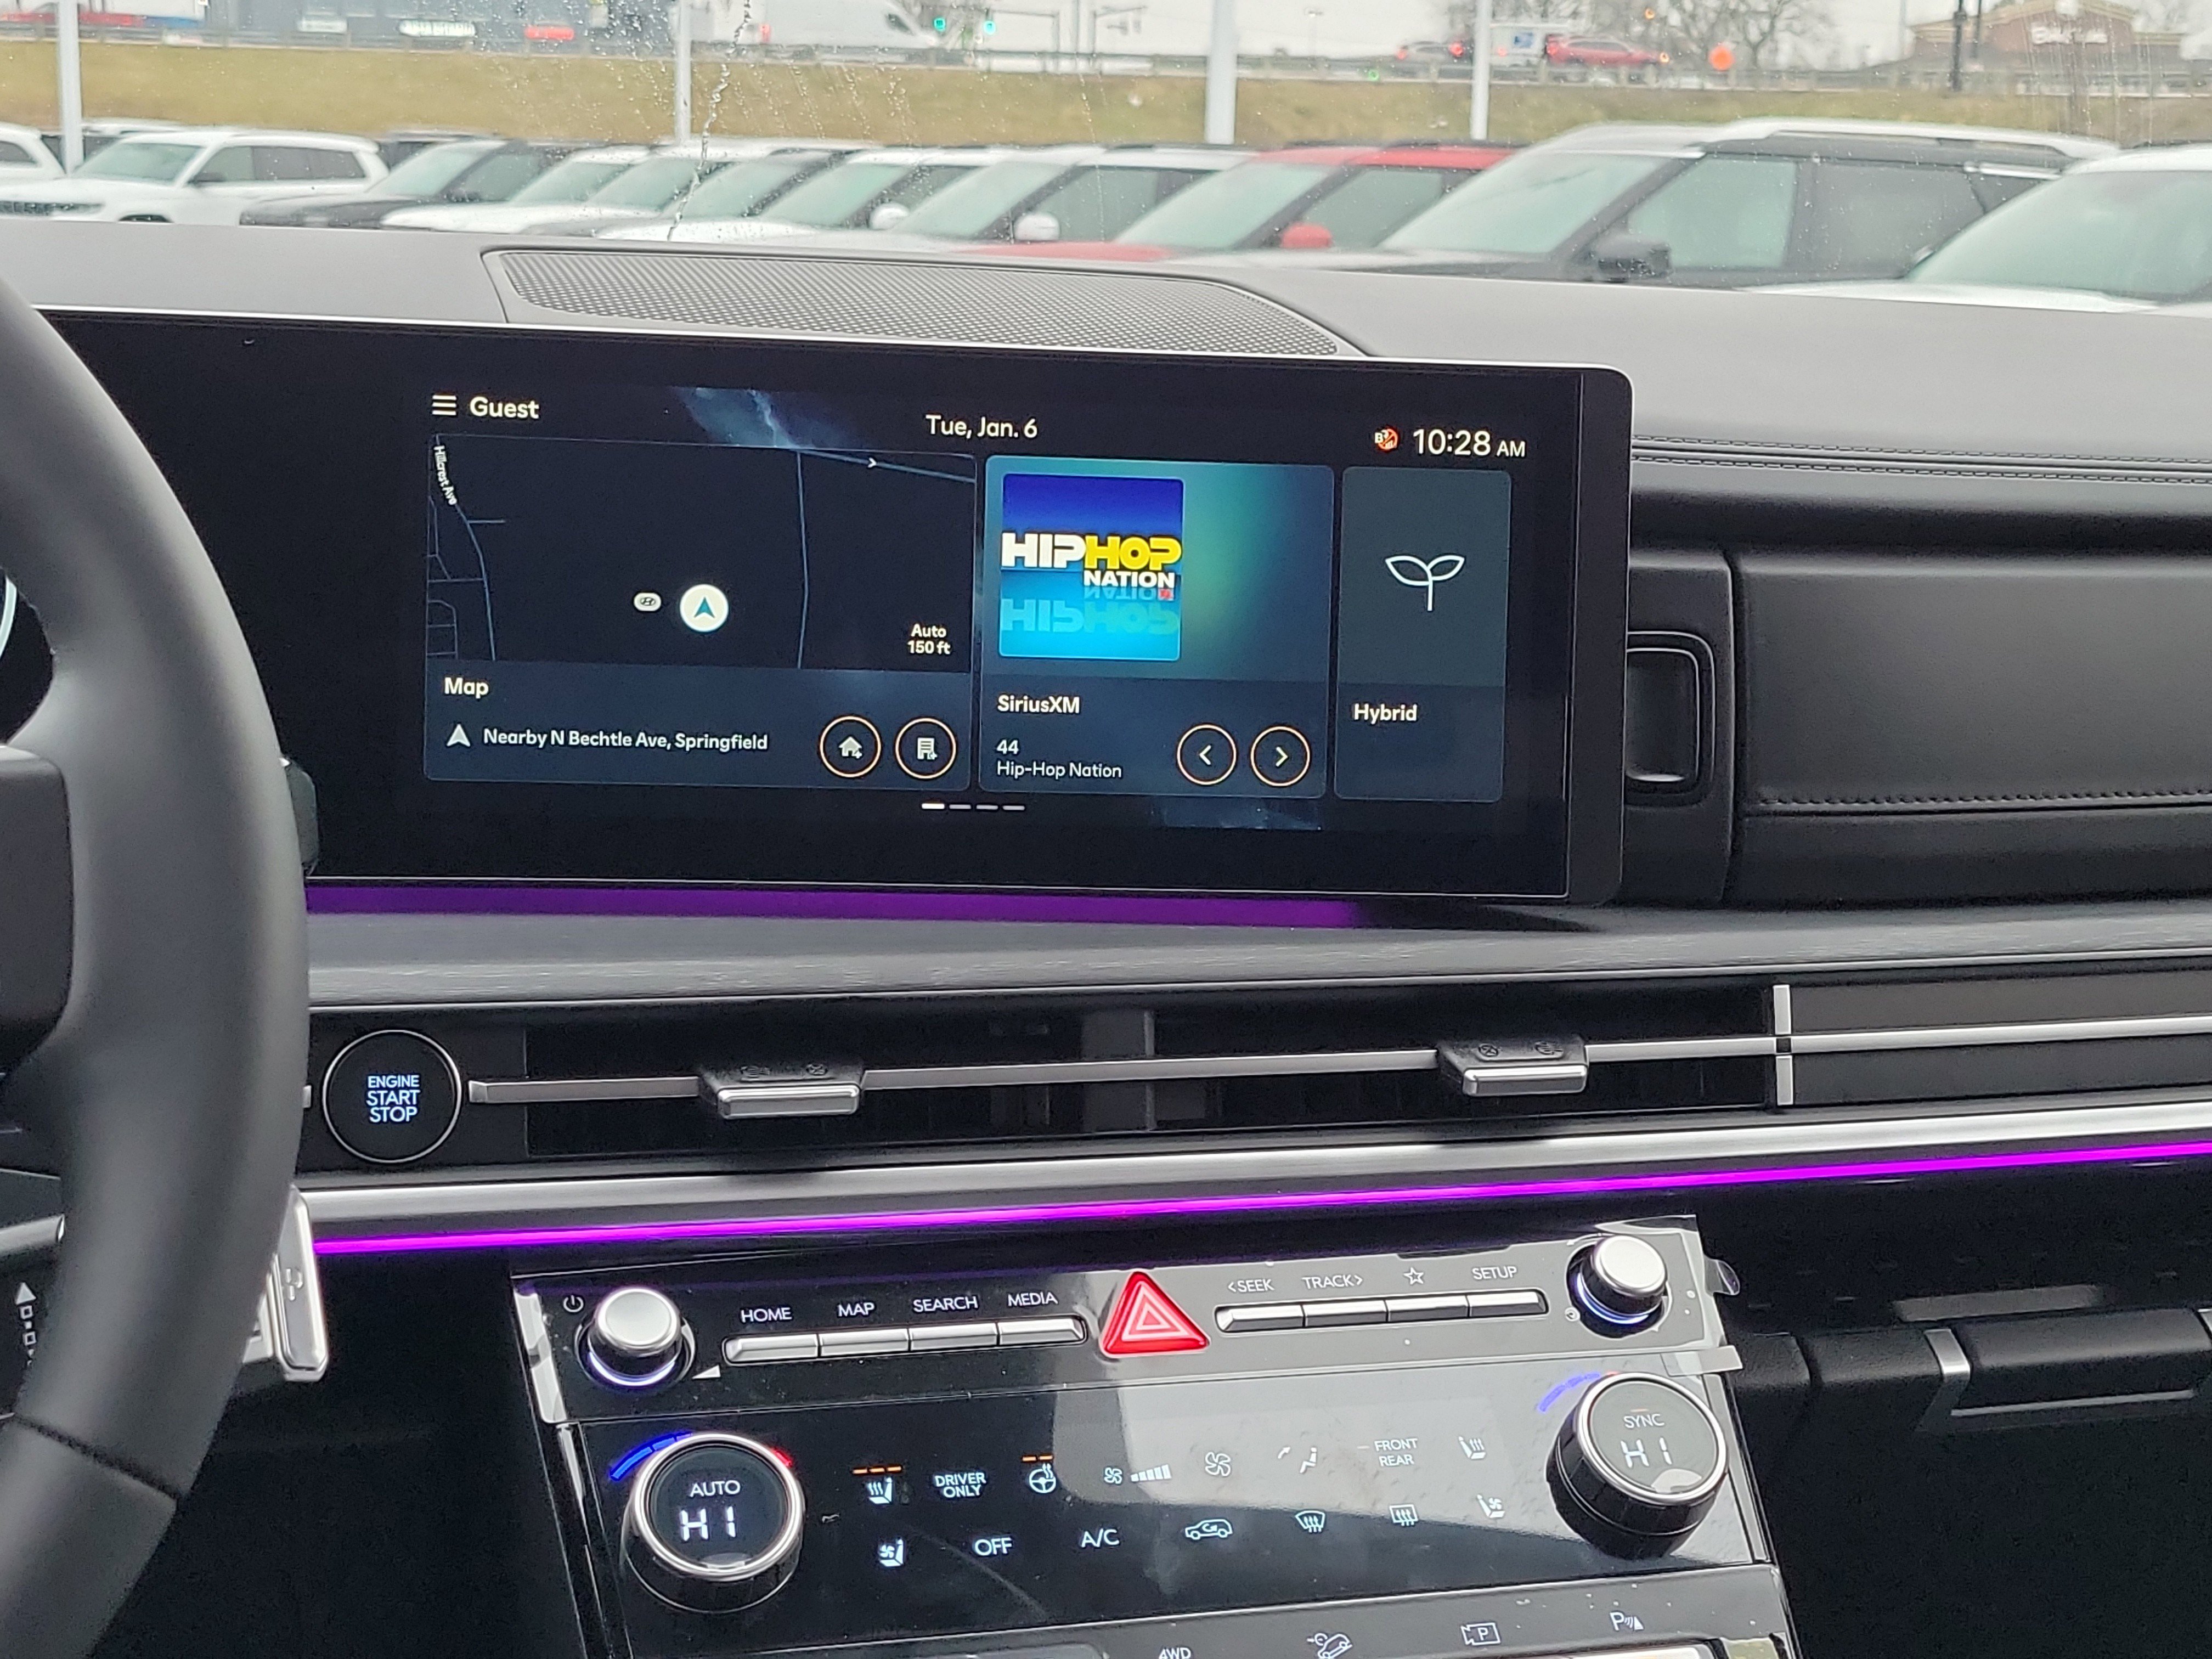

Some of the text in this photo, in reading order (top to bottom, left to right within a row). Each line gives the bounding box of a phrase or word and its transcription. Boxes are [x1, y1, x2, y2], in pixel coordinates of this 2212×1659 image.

[470, 396, 539, 419] Guest
[926, 414, 1037, 439] Tue, Jan. 6
[1413, 428, 1525, 457] 10:28 AM
[442, 486, 458, 505] Ave
[1084, 570, 1175, 589] NATION
[911, 623, 947, 638] Auto
[907, 640, 951, 654] 150 ft
[444, 677, 489, 699] Map
[997, 695, 1080, 714] SiriusXM
[1354, 703, 1418, 724] Hybrid
[484, 728, 768, 752] Nearby N Bechtle Ave, Springfield
[996, 740, 1019, 754] 44
[997, 760, 1121, 780] Hip-Hop Nation
[368, 1075, 420, 1088] ENGINE
[366, 1090, 421, 1106] START
[369, 1107, 417, 1123] STOP
[1472, 1266, 1517, 1280] SETUP
[913, 1296, 978, 1312] SEARCH
[1008, 1291, 1058, 1306] MEDIA
[741, 1307, 792, 1323] HOME
[838, 1302, 874, 1317] MAP
[1623, 1413, 1664, 1428] SYNC
[1374, 1438, 1418, 1452] FRONT
[1620, 1437, 1672, 1468] HI
[1379, 1454, 1415, 1467] REAR
[934, 1472, 987, 1488] DRIVER
[690, 1480, 741, 1497] AUTO
[943, 1485, 981, 1498] ONLY
[679, 1506, 736, 1541] HI
[1081, 1528, 1120, 1548] A/C
[974, 1537, 1012, 1556] OFF
[1158, 1647, 1191, 1659] 4WD
